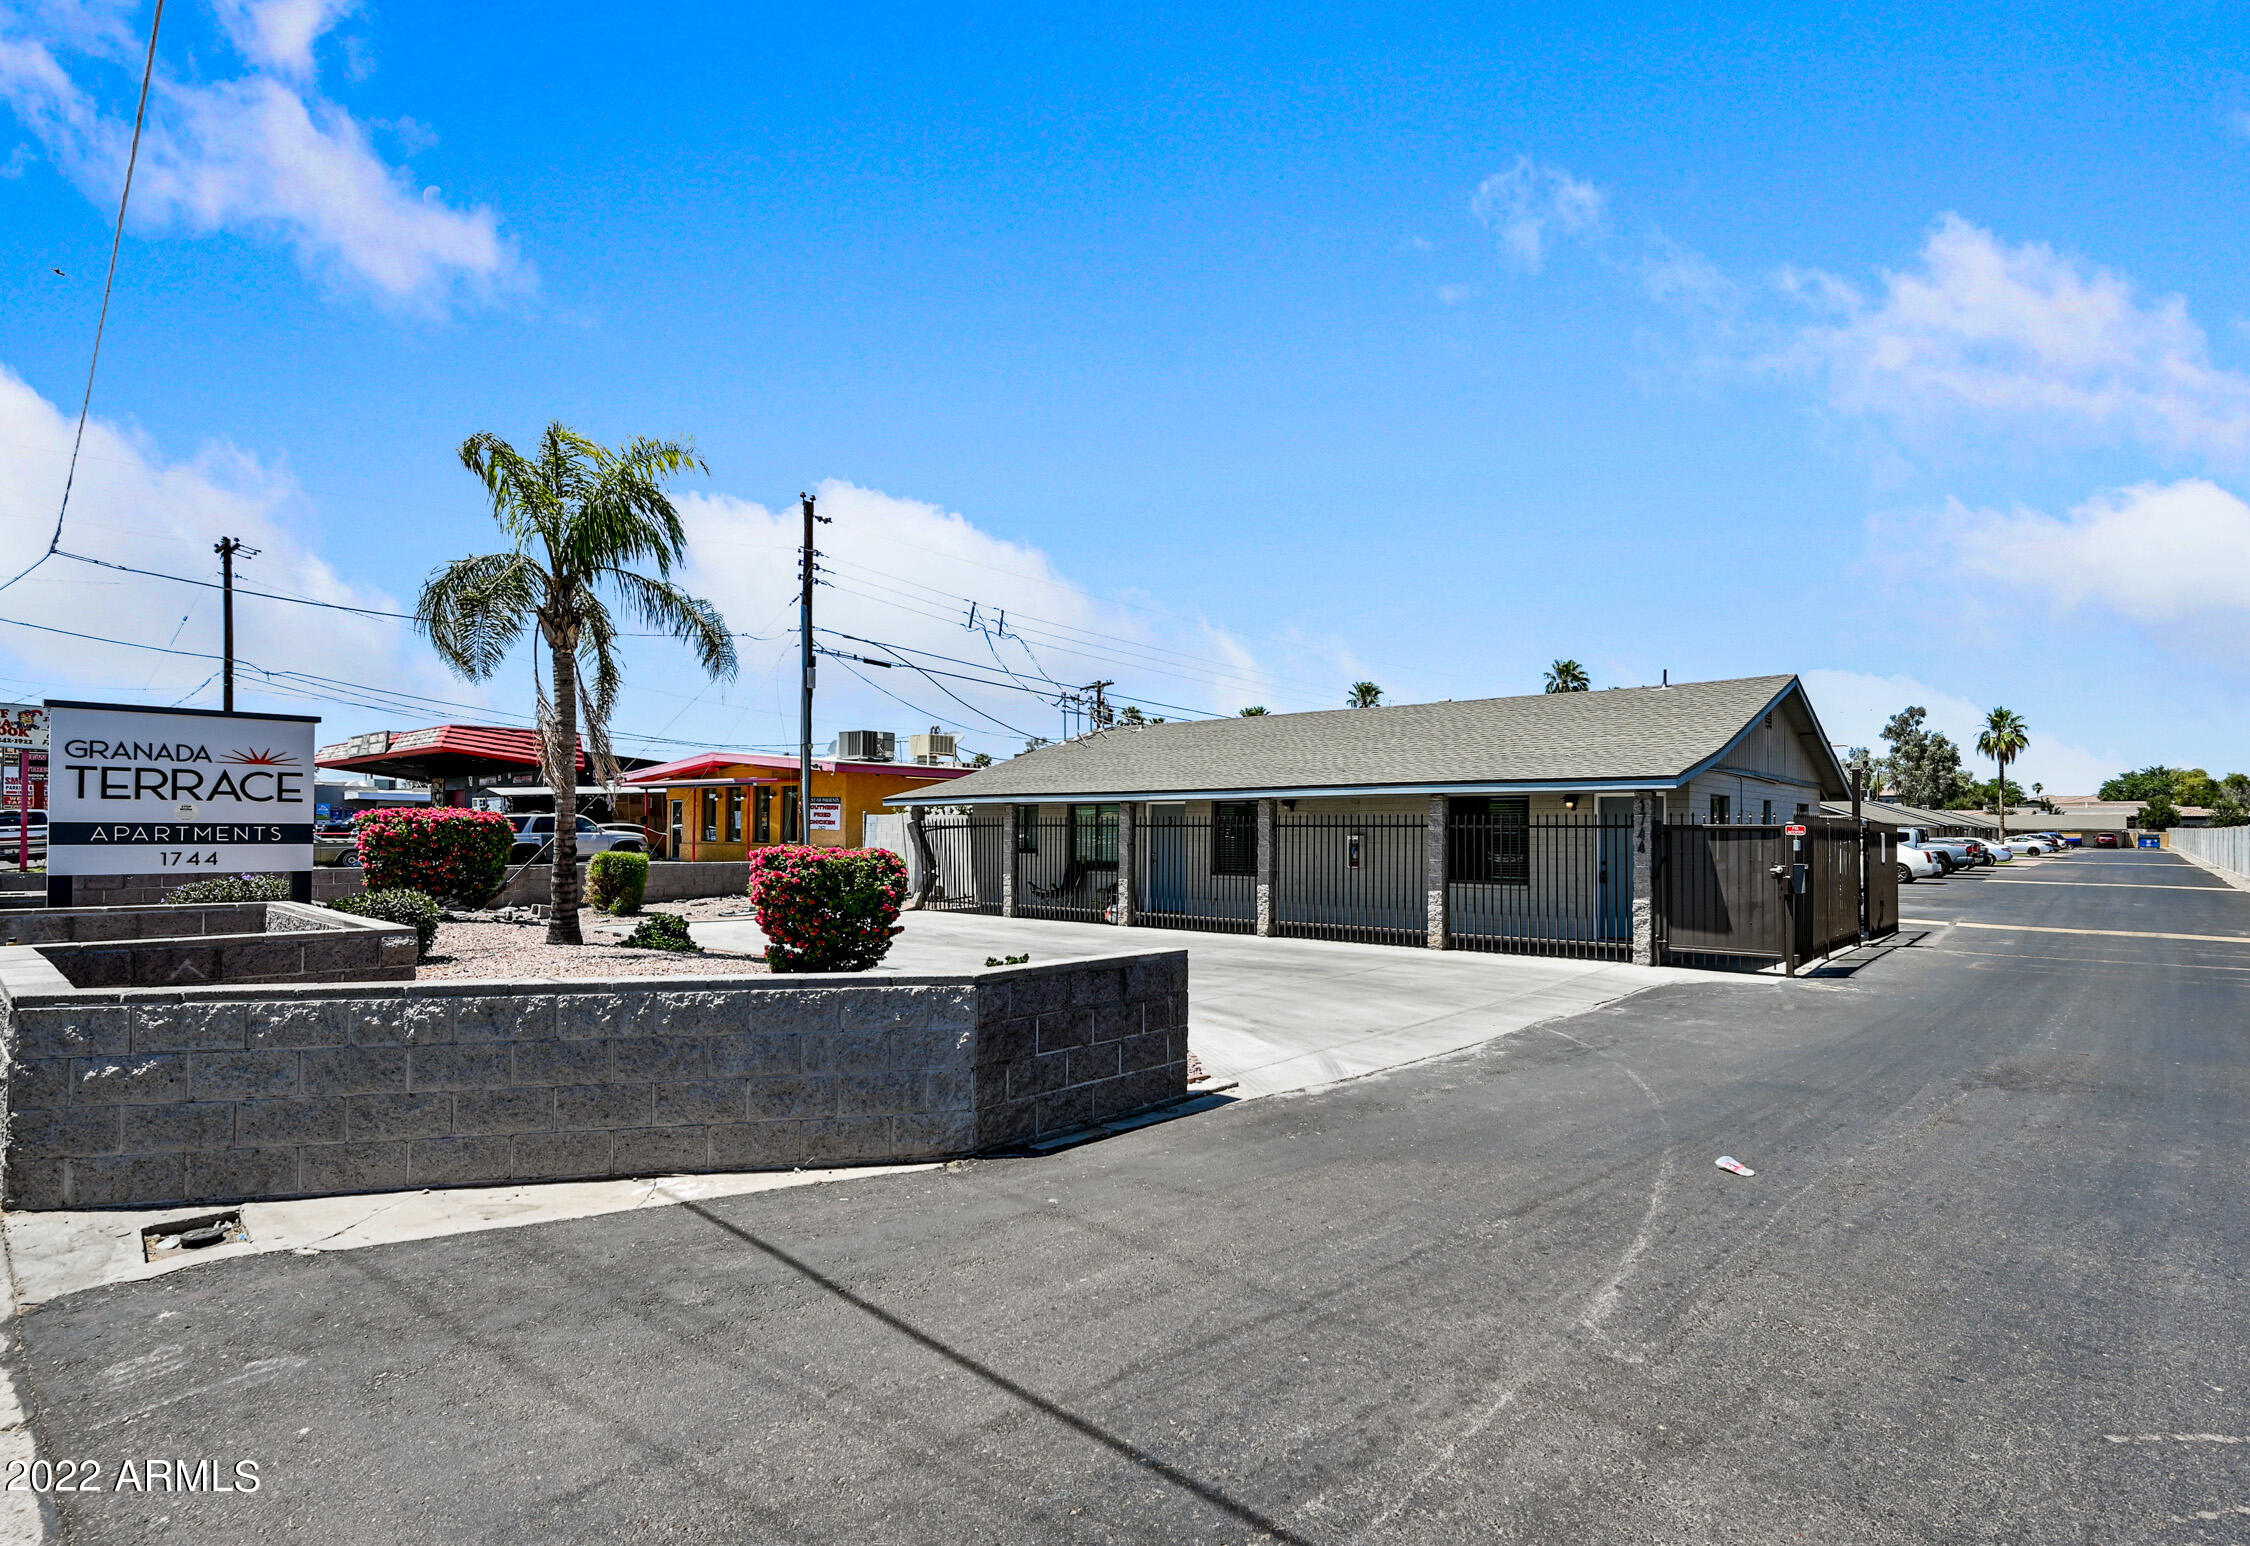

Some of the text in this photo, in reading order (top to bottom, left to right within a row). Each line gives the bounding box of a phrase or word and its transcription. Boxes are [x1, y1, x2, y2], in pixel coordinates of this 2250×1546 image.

[0, 726, 30, 738] OOK
[64, 739, 213, 763] GRANADA
[65, 765, 304, 803] TERRACE
[90, 826, 283, 842] APARTMENTS
[160, 852, 219, 866] 1744
